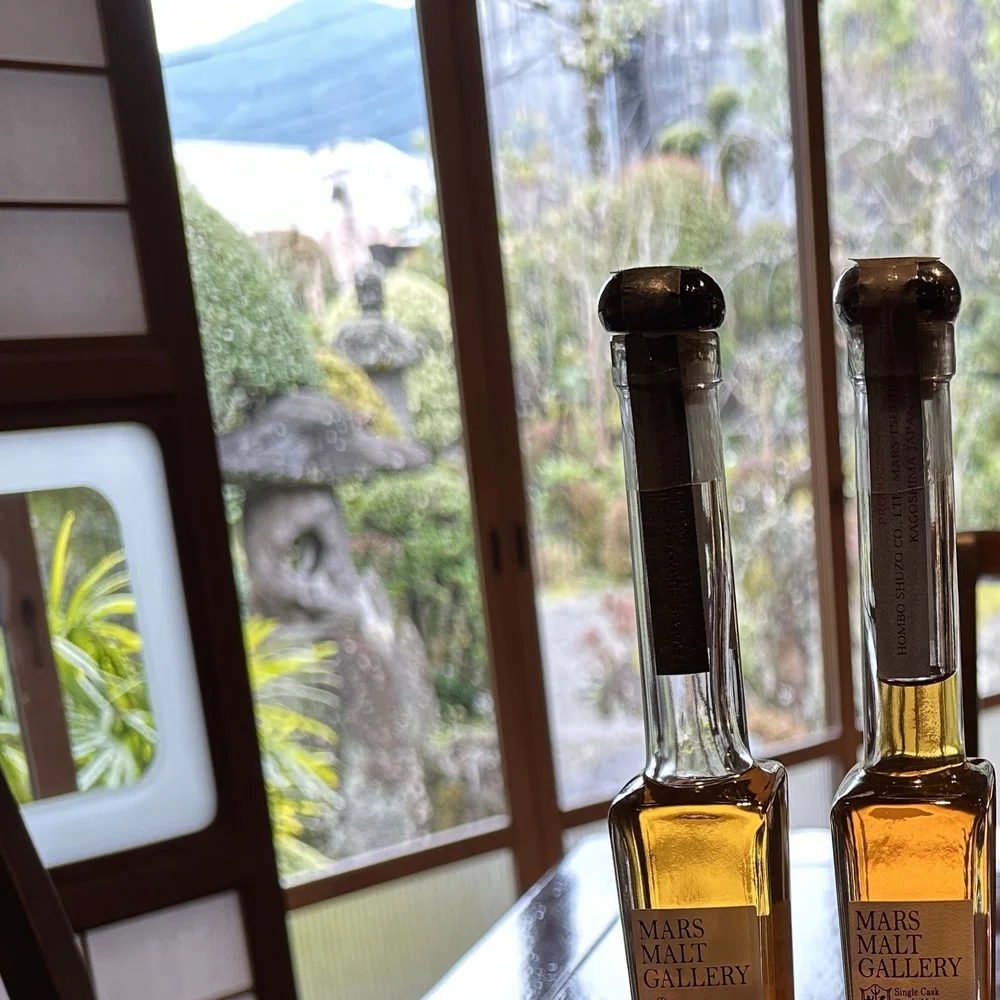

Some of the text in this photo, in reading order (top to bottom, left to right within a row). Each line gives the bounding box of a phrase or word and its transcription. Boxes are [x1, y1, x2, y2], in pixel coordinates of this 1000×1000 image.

[889, 441, 900, 482] MARS
[905, 405, 918, 542] KAGOSHIMA JAPAN
[894, 552, 905, 599] SHUZO
[896, 603, 907, 656] HOMBO
[638, 918, 705, 940] MARS
[855, 910, 920, 931] MARS
[640, 942, 708, 964] MALT
[857, 934, 922, 955] MALT
[643, 964, 750, 989] GALLERY
[858, 957, 963, 978] GALLERY
[894, 987, 940, 997] Single Cask
